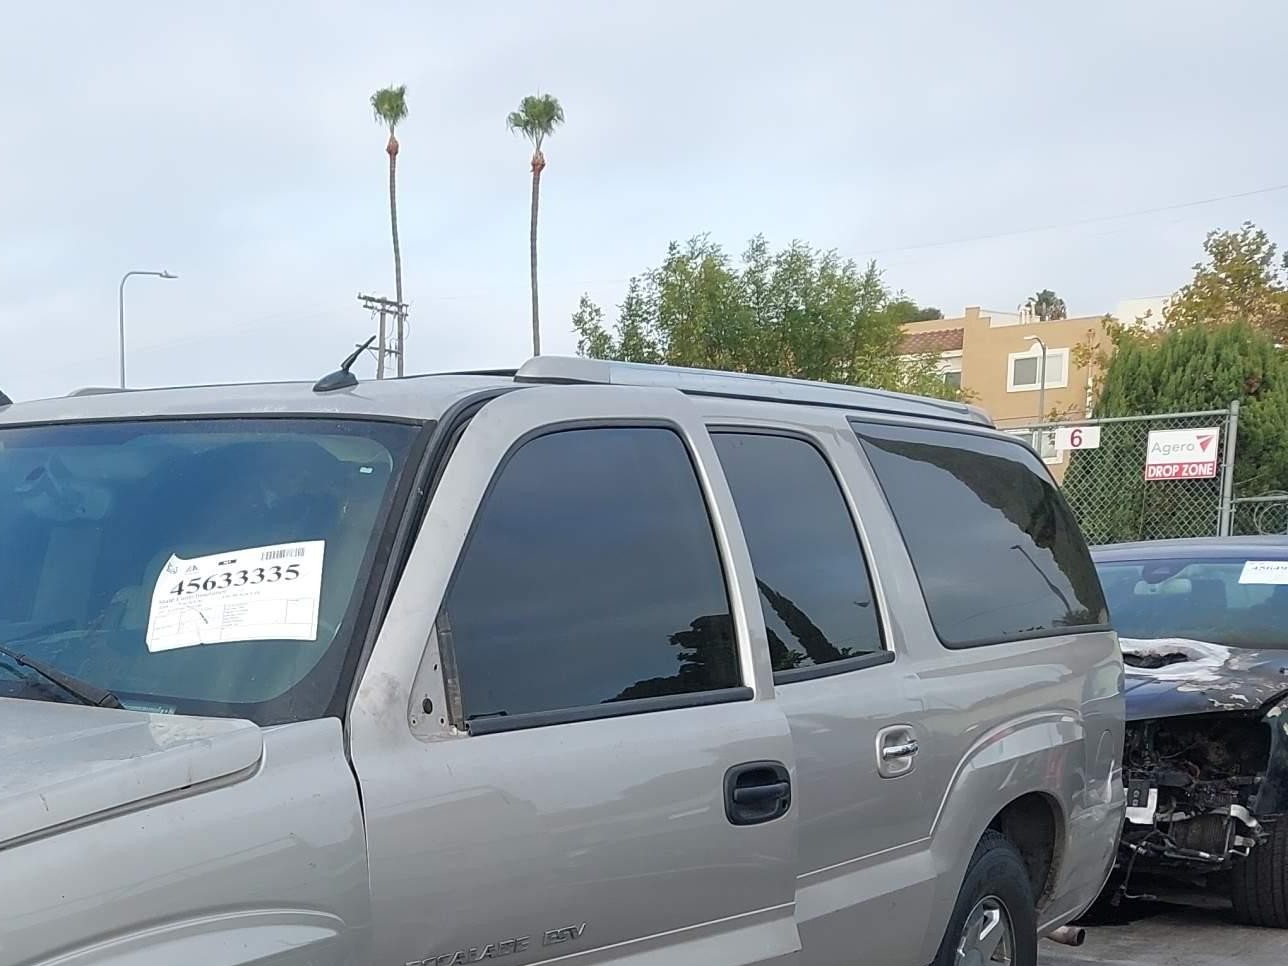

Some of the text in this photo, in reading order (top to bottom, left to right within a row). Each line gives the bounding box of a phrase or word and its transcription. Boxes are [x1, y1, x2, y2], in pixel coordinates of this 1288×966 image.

[1070, 429, 1083, 447] 6
[1151, 442, 1195, 456] Agero
[1148, 463, 1214, 478] DROP ZONE
[170, 563, 300, 596] 45633335
[543, 921, 587, 946] ESV
